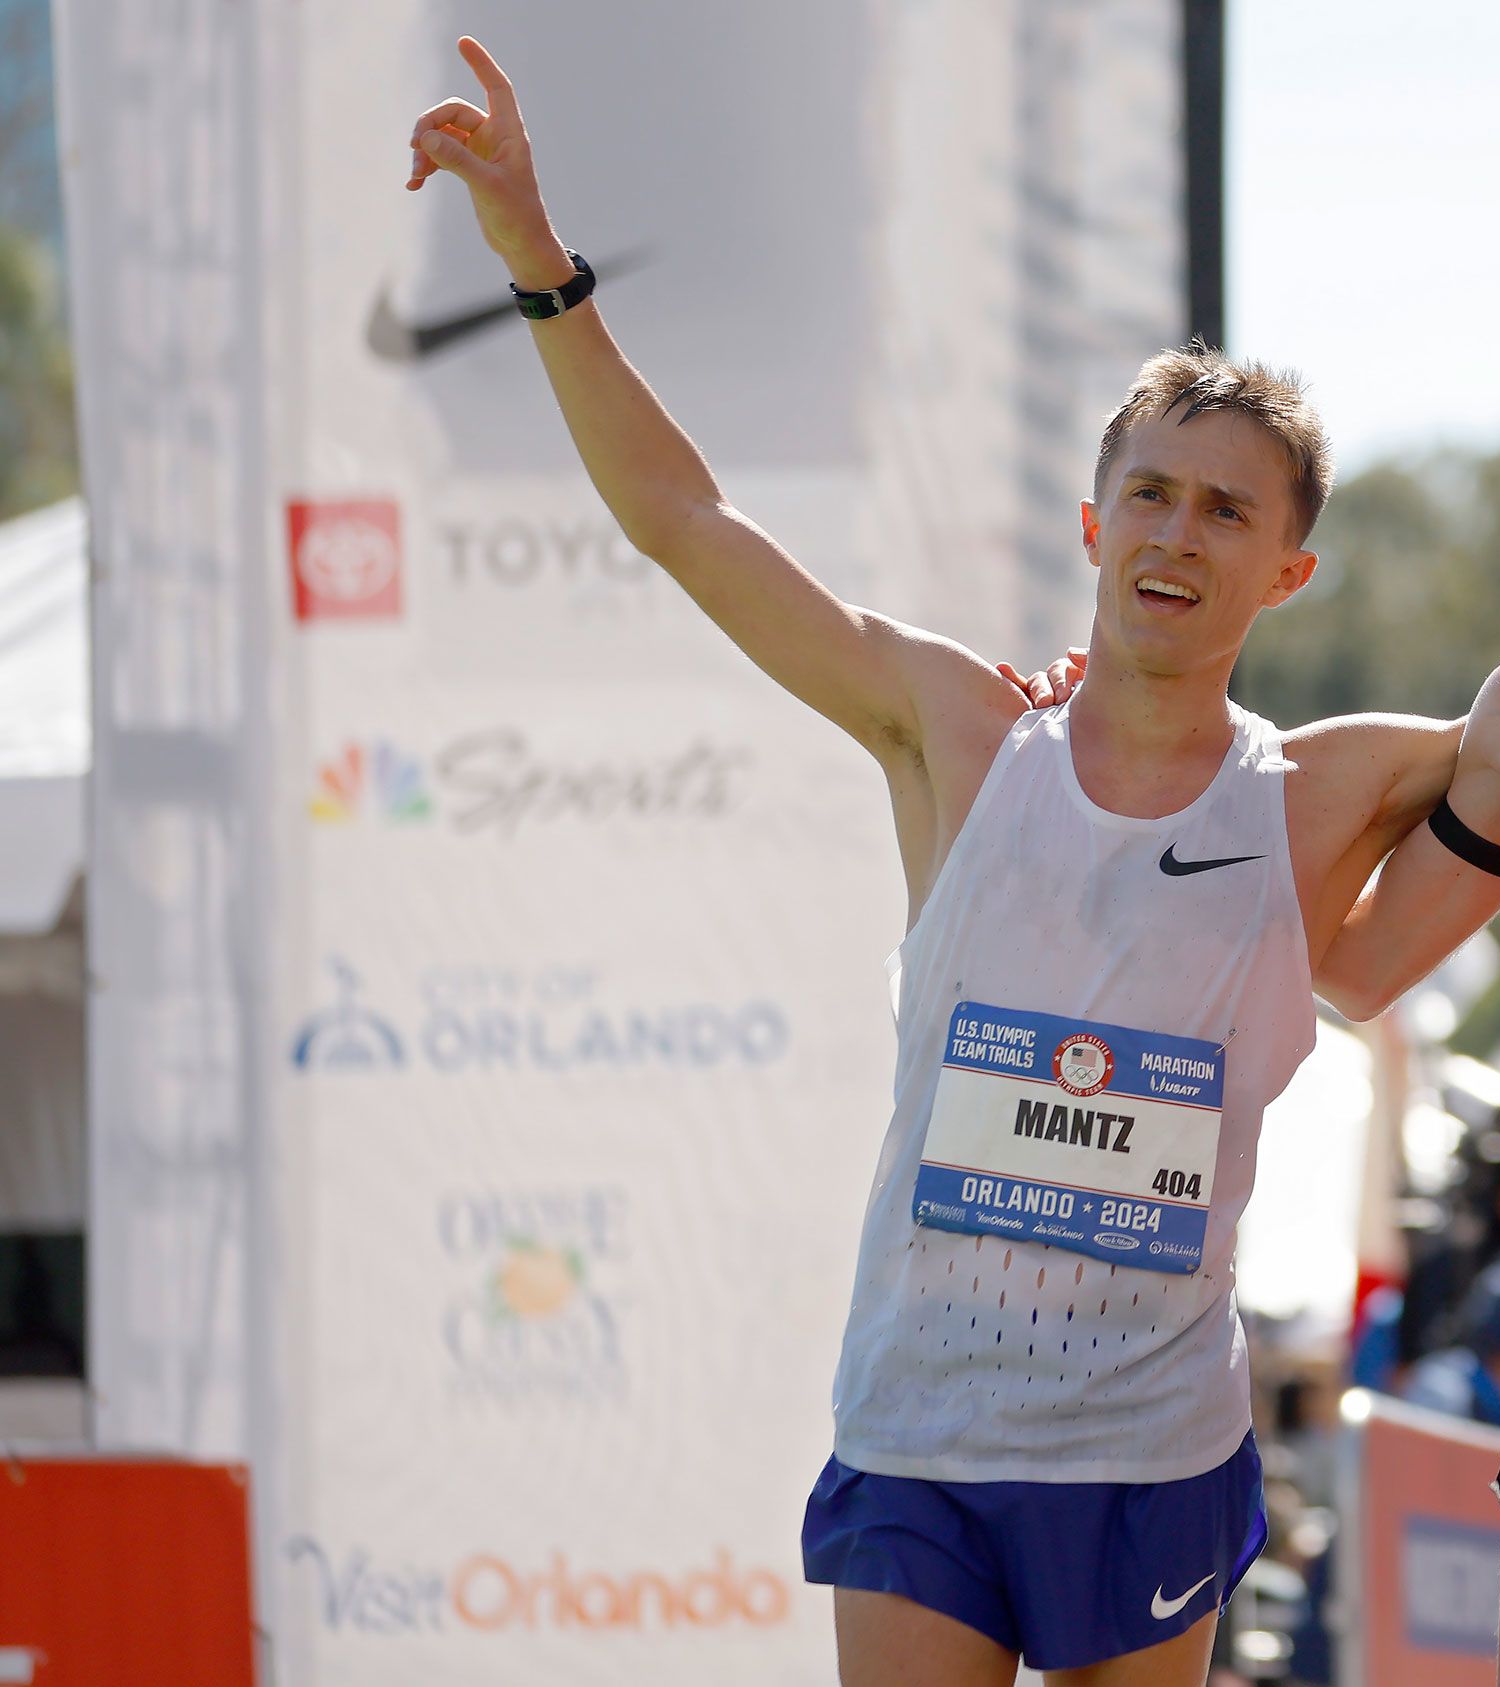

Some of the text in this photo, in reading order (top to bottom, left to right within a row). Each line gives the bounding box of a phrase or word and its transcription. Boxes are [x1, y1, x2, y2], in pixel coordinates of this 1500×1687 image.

[438, 522, 656, 584] TOYO
[435, 727, 756, 841] Sports
[420, 998, 791, 1070] ORLANDO
[952, 1039, 1035, 1069] TEAM TRIALS
[956, 1018, 1037, 1048] U.S. OLYMPIC
[1140, 1052, 1216, 1081] MARATHON
[1165, 1081, 1201, 1097] USATF
[1013, 1098, 1136, 1154] MANTZ
[961, 1176, 1075, 1220] ORLANDO
[1099, 1199, 1162, 1234] 2024
[1151, 1168, 1202, 1200] 404
